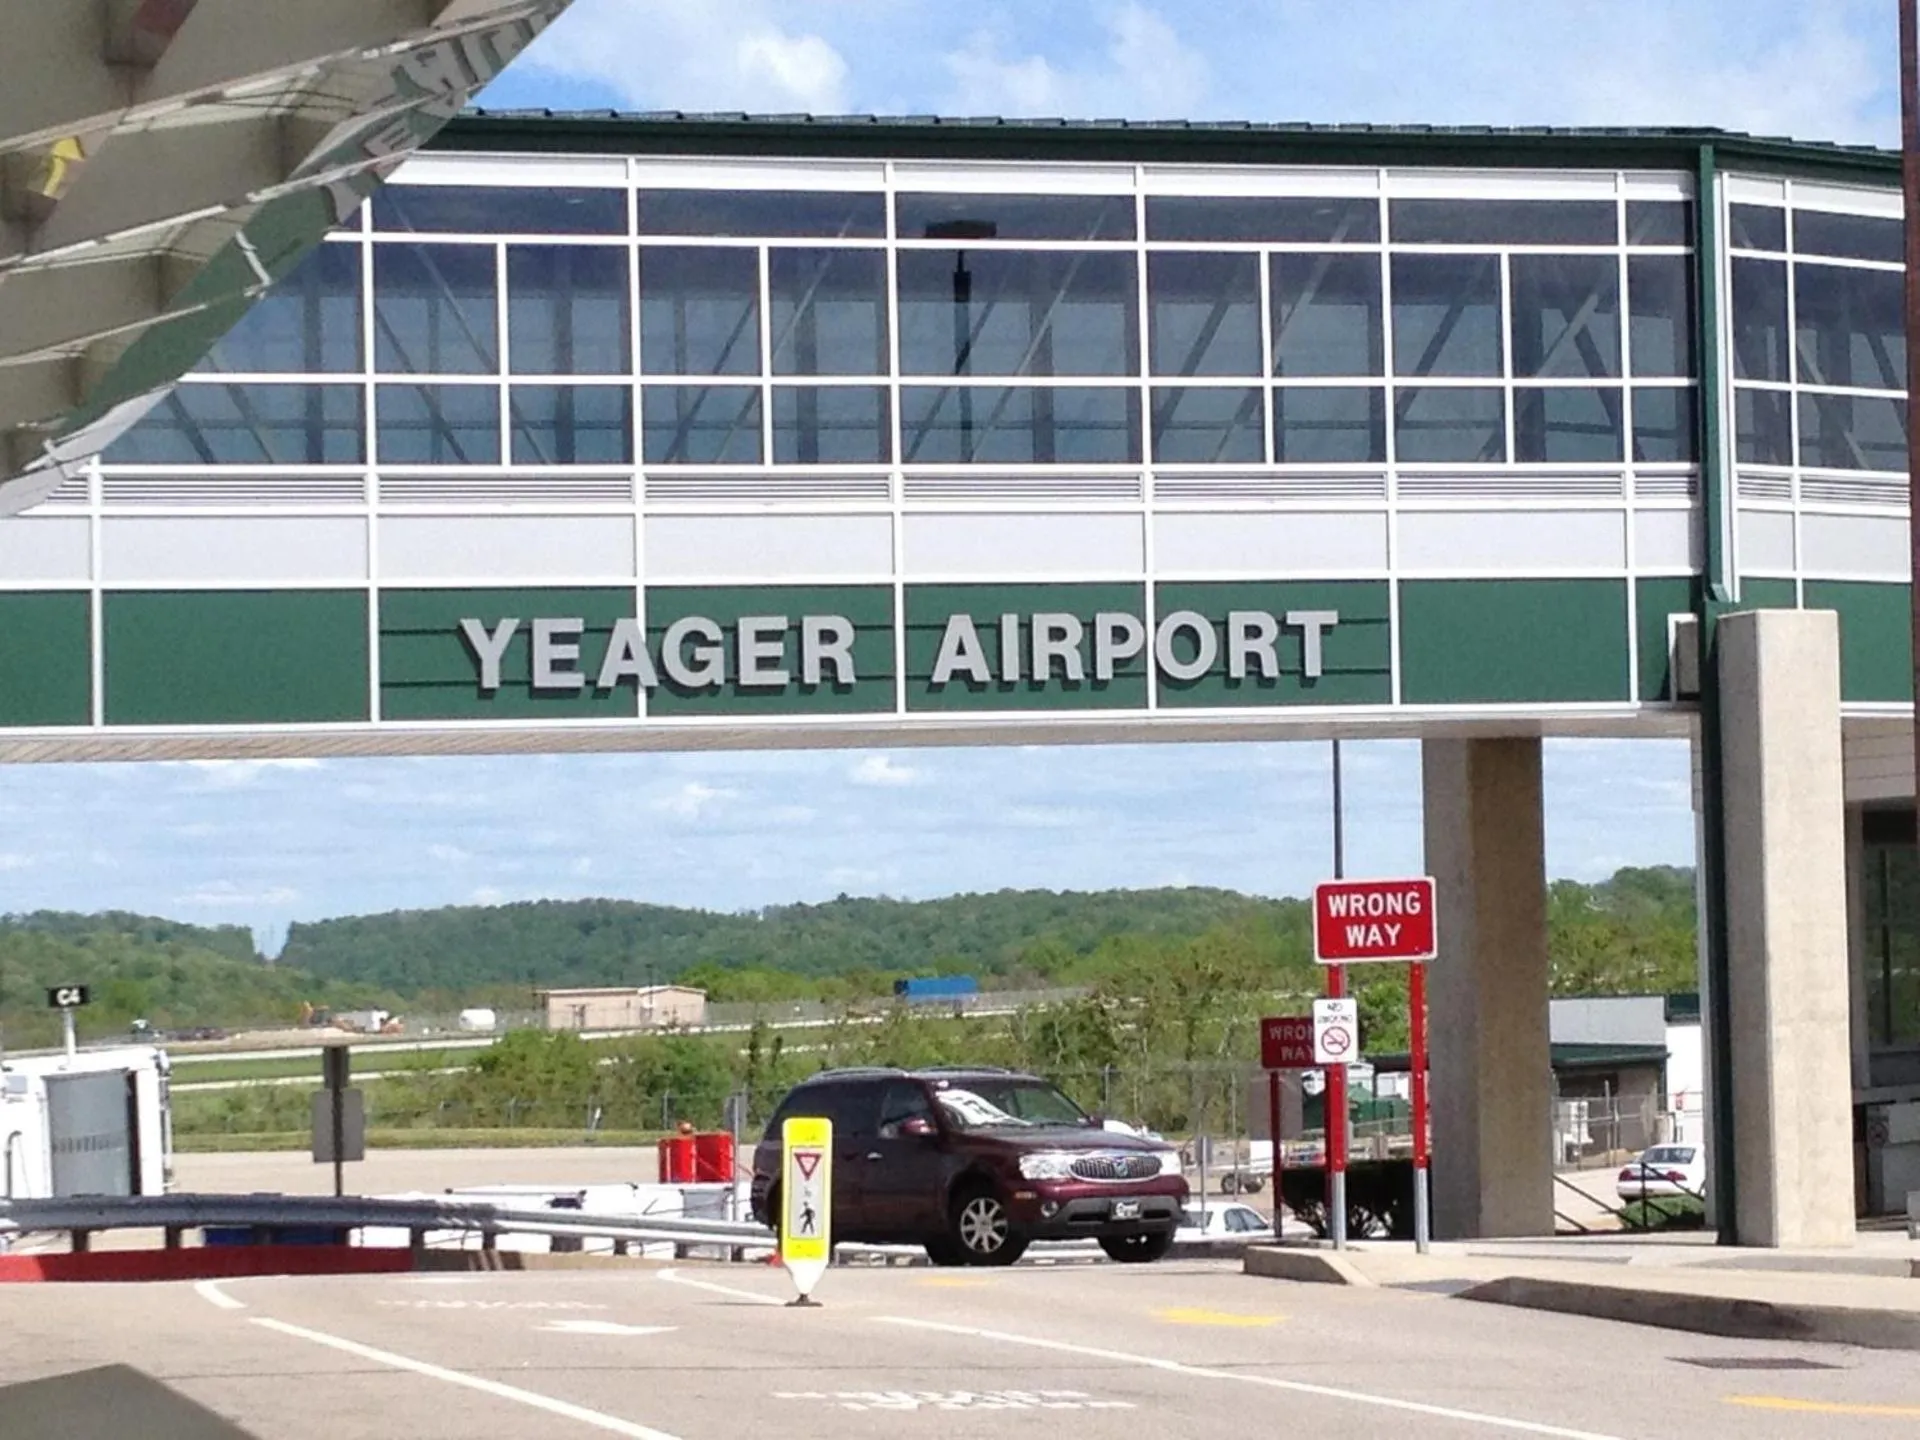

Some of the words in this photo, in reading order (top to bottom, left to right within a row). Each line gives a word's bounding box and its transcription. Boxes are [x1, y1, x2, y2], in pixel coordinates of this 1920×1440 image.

[460, 616, 857, 689] YEAGER
[931, 610, 1339, 684] AIRPORT
[1327, 891, 1421, 917] WRONG
[1345, 922, 1402, 948] WAY
[57, 988, 80, 1005] C4
[1269, 1023, 1314, 1041] WRON
